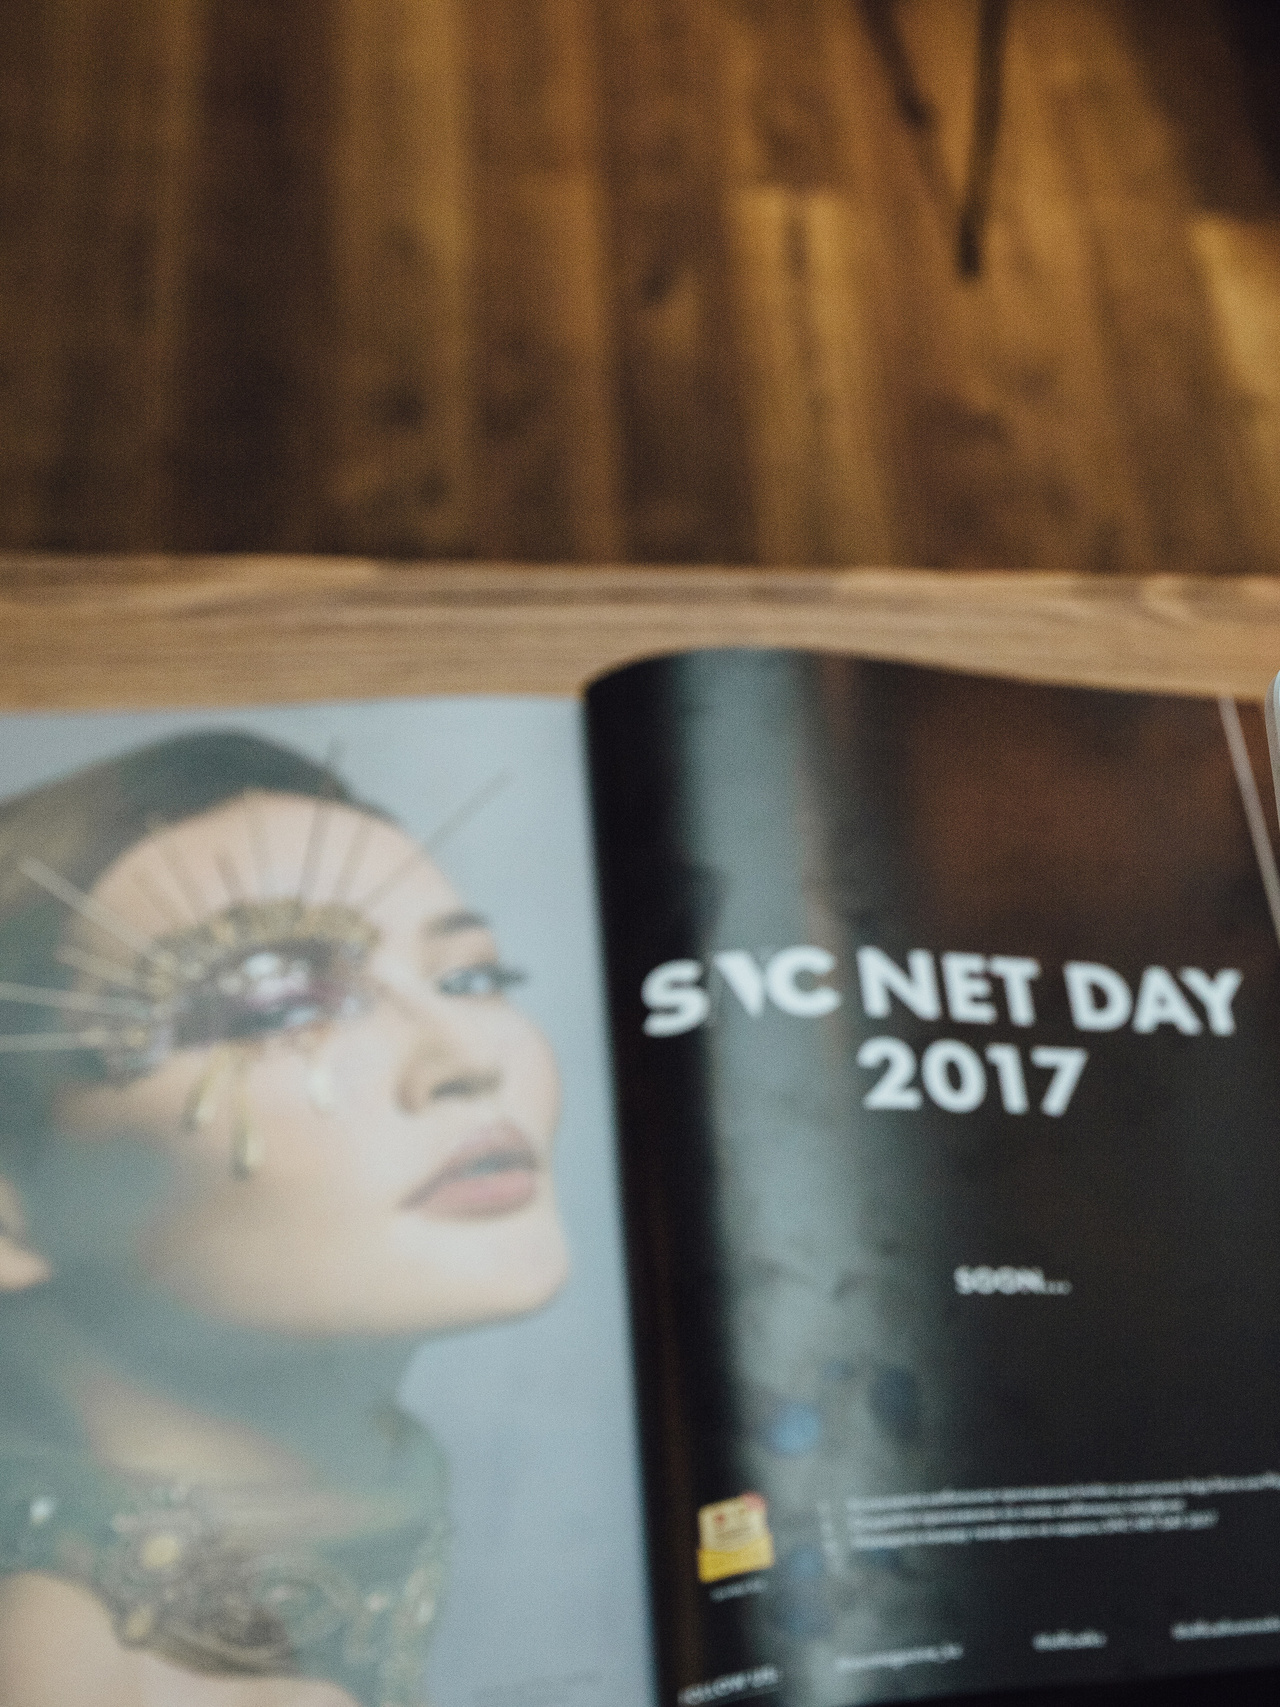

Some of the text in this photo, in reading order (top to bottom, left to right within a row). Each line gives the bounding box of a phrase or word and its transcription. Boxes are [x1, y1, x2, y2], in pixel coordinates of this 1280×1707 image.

[642, 945, 1243, 1037] SNC NET DAY
[855, 1035, 1089, 1118] 2017
